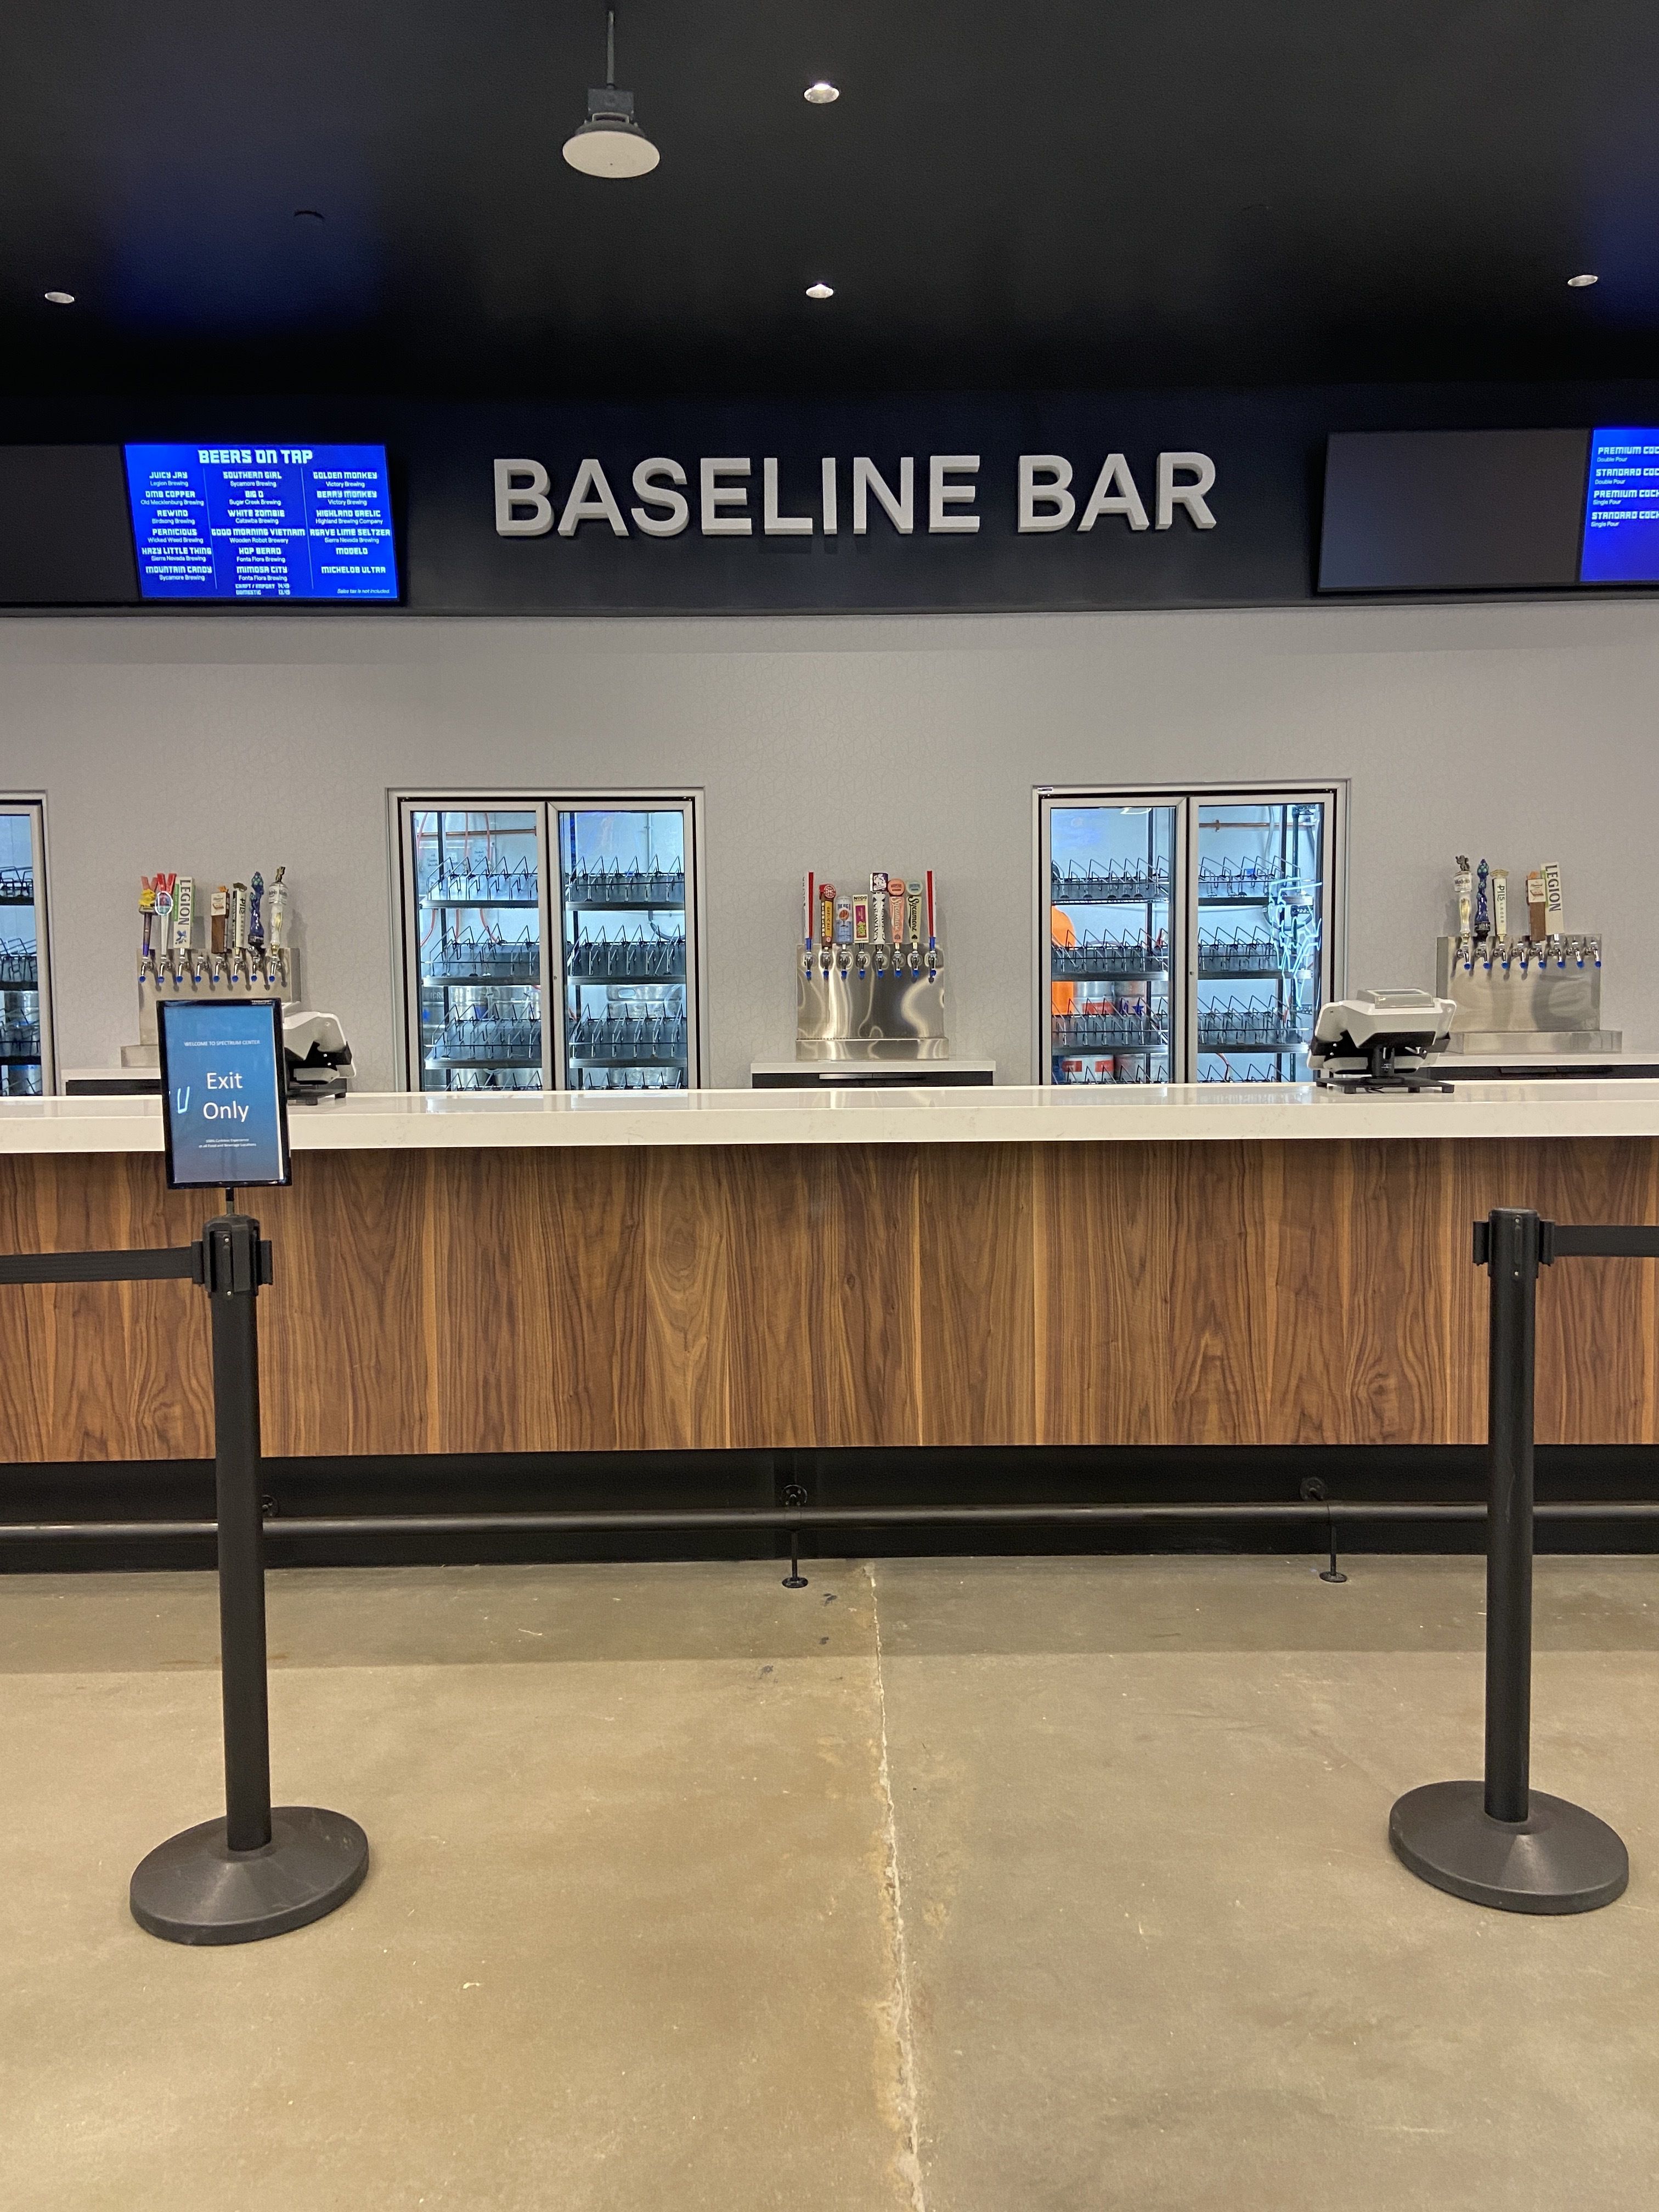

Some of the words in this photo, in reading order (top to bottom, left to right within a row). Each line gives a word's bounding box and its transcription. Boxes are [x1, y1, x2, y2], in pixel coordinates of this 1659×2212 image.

[198, 449, 252, 464] BEERS
[255, 449, 278, 464] ON
[280, 449, 313, 464] TAP
[1598, 447, 1641, 455] PREMIUM
[493, 455, 980, 536] BASELINE
[1017, 452, 1216, 533] BAR
[1594, 489, 1638, 498] PREMIUM
[1592, 511, 1638, 520] STANDARD
[1545, 865, 1561, 912] LEGION
[178, 879, 191, 926] LEGION
[908, 896, 919, 932] Sycamore
[207, 1072, 243, 1090] Exit
[203, 1101, 249, 1122] Only
